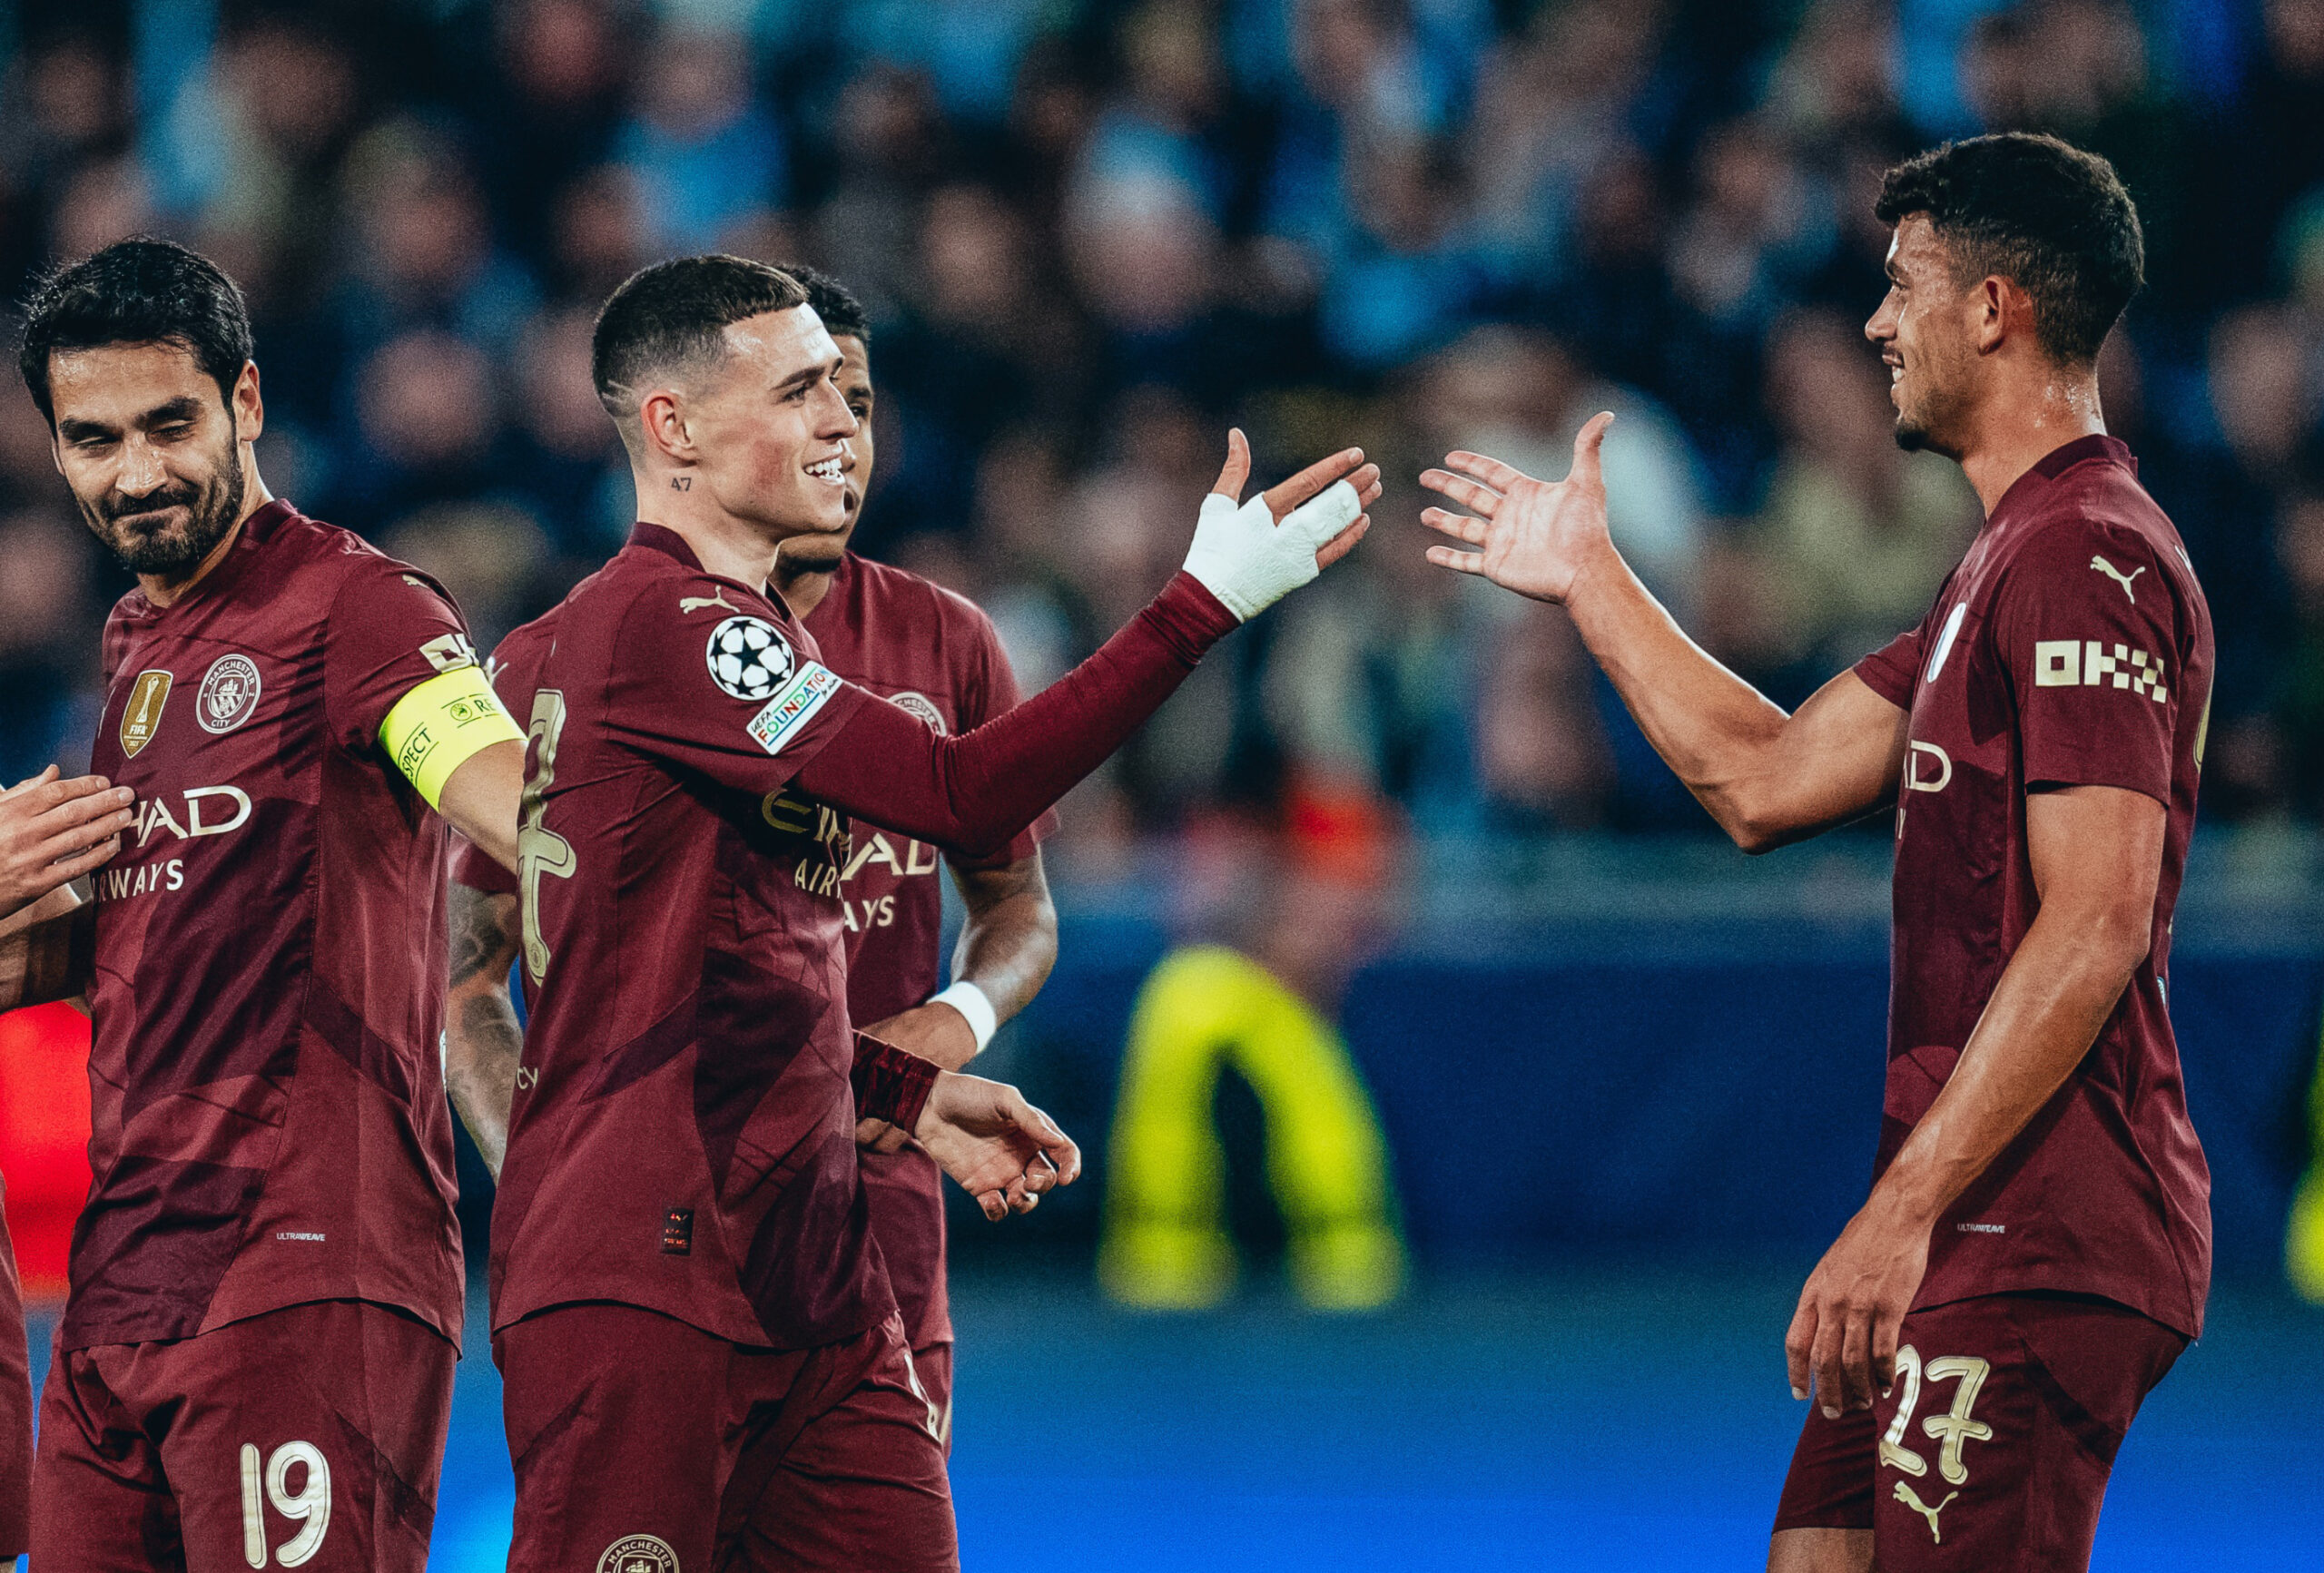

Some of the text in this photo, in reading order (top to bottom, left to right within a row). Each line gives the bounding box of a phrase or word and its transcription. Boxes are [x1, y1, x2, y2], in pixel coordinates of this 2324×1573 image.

[671, 477, 692, 491] 47
[208, 661, 255, 686] MANCHESTER
[129, 723, 146, 735] FIFA
[211, 719, 231, 727] CITY
[401, 727, 432, 782] SPECT
[129, 785, 252, 848] HAD
[276, 1232, 326, 1242] ULTRAWEAVE
[1879, 1344, 1993, 1485] 27
[240, 1440, 331, 1569] 19
[607, 1540, 672, 1568] MANCHESTER
